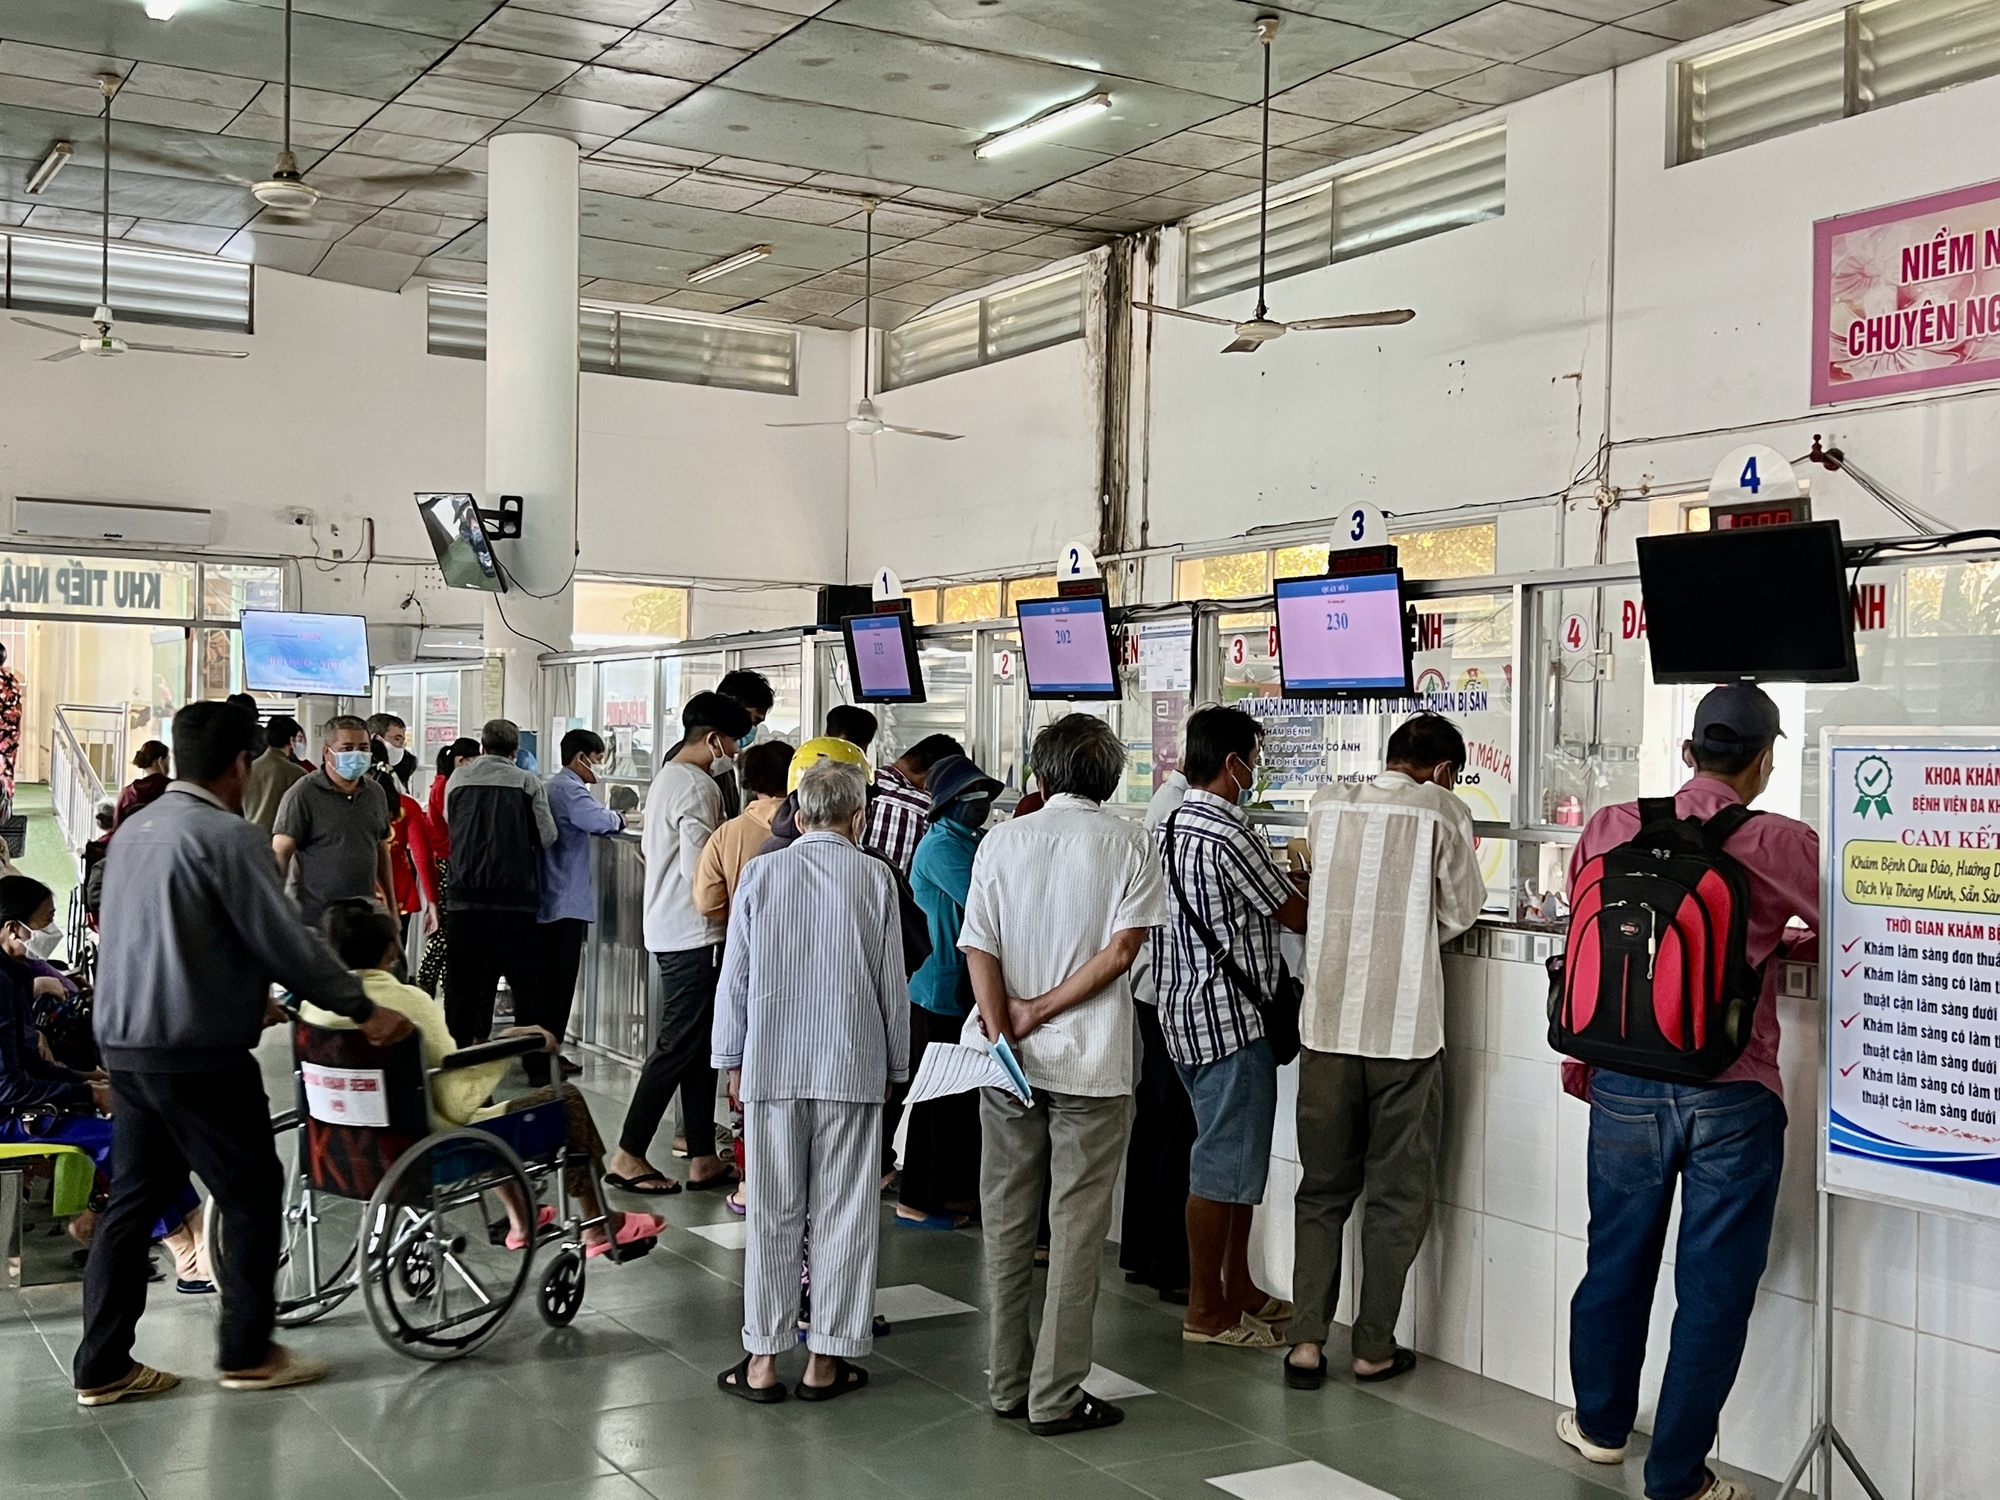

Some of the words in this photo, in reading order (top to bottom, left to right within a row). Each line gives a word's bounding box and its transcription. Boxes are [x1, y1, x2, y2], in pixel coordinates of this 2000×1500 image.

[1902, 227, 1974, 283] NIỀM
[1849, 300, 1956, 356] CHUYÊN
[1740, 457, 1760, 494] 4
[1351, 510, 1364, 541] 3
[1070, 549, 1080, 574] 2
[882, 572, 889, 594] 1
[1326, 612, 1348, 630] 230
[1567, 618, 1580, 648] 4
[1055, 629, 1071, 643] 202
[1002, 654, 1009, 674] 2
[1234, 639, 1243, 664] 3
[840, 664, 844, 682] 1
[1458, 692, 1467, 717] BỊ
[1287, 725, 1310, 737] BỆNH
[1341, 740, 1360, 751] ẢNH
[1477, 739, 1502, 772] MÁU
[1337, 771, 1364, 783] PHIẾU
[1465, 773, 1480, 784] CÓ
[1925, 767, 1961, 785] KHOA
[1912, 794, 1940, 815] BỆNH
[1943, 795, 1967, 816] VIỆN
[1970, 798, 1985, 813] ĐA
[1901, 828, 1951, 848] CAM
[1851, 855, 1878, 870] Khám
[1881, 856, 1905, 874] Bệnh
[1908, 858, 1927, 873] Chu
[1930, 859, 1953, 877] Đáo,
[1956, 860, 1991, 880] Hướng
[1856, 880, 1877, 898] Dịch
[1880, 881, 1893, 900] Vụ
[1896, 882, 1924, 902] Thông
[1927, 884, 1956, 904] Minh,
[1959, 884, 1979, 902] Sẵn
[1886, 916, 1911, 934] THỜI
[1916, 919, 1943, 936] GIAN
[1948, 921, 1984, 940] KHÁM
[1864, 941, 1894, 956] Khám
[1898, 944, 1918, 959] lâm
[1922, 947, 1948, 963] sàng
[1952, 949, 1973, 965] đơn
[1864, 966, 1894, 982] Khám
[1898, 970, 1918, 985] lâm
[1921, 973, 1948, 990] sàng
[1952, 976, 1965, 990] có
[1970, 978, 1991, 993] làm
[1864, 993, 1890, 1011] thuật
[1894, 996, 1913, 1013] cận
[1917, 999, 1937, 1014] lâm
[1941, 1001, 1968, 1019] sàng
[1972, 1005, 1997, 1021] dưới
[1863, 1017, 1893, 1034] Khám
[1897, 1022, 1917, 1037] lâm
[1921, 1025, 1948, 1043] sàng
[1951, 1029, 1965, 1043] có
[1969, 1031, 1990, 1047] làm
[1863, 1043, 1890, 1061] thuật
[1893, 1047, 1913, 1064] cận
[1917, 1050, 1937, 1065] lâm
[1941, 1054, 1968, 1072] sàng
[1972, 1058, 1996, 1075] dưới
[1863, 1067, 1893, 1084] Khám
[1897, 1072, 1917, 1087] lâm
[1920, 1076, 1947, 1094] sàng
[1951, 1081, 1964, 1095] có
[1969, 1083, 1990, 1099] làm
[1862, 1090, 1889, 1109] thuật
[1892, 1096, 1912, 1113] cận
[1916, 1099, 1936, 1115] lâm
[1940, 1103, 1967, 1121] sàng
[1971, 1108, 1996, 1125] dưới
